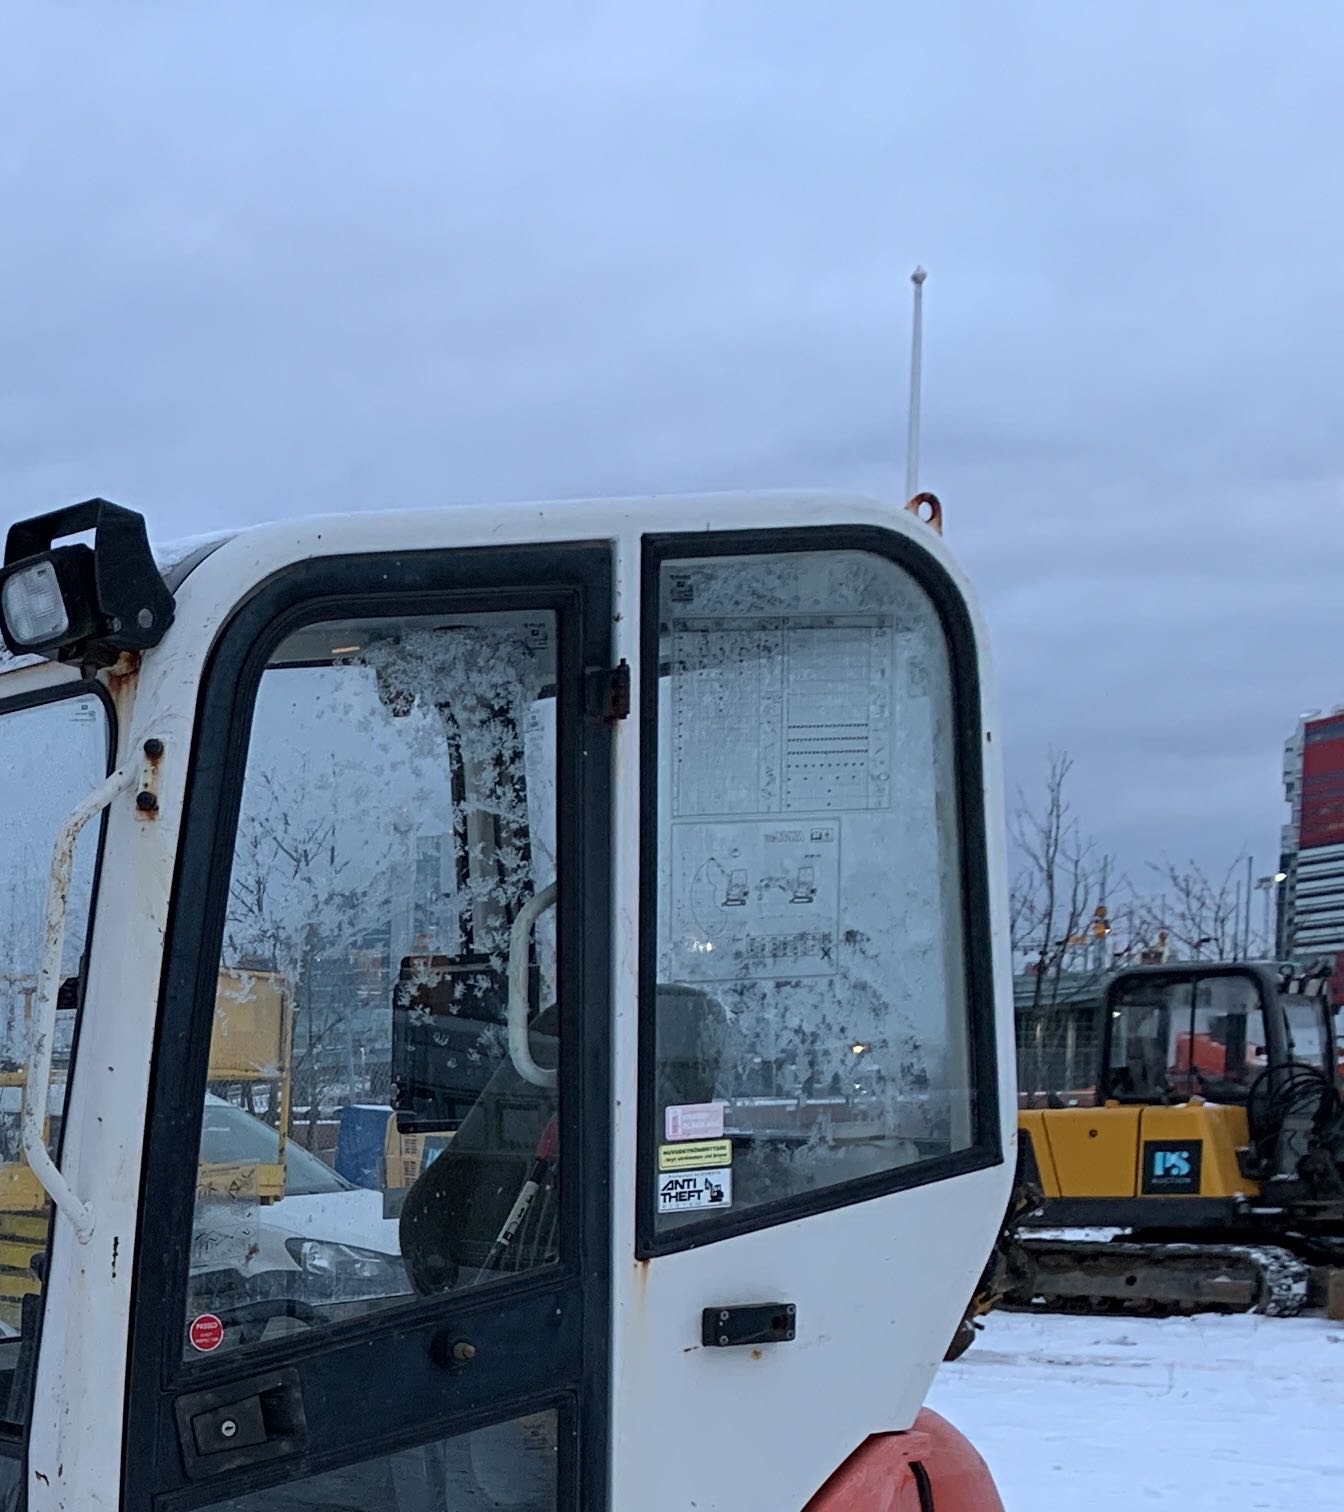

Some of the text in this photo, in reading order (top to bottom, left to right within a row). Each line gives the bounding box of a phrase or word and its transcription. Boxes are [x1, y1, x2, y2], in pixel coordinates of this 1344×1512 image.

[1154, 1151, 1191, 1176] PS
[661, 1178, 697, 1191] ANTI
[660, 1189, 704, 1203] THEFT
